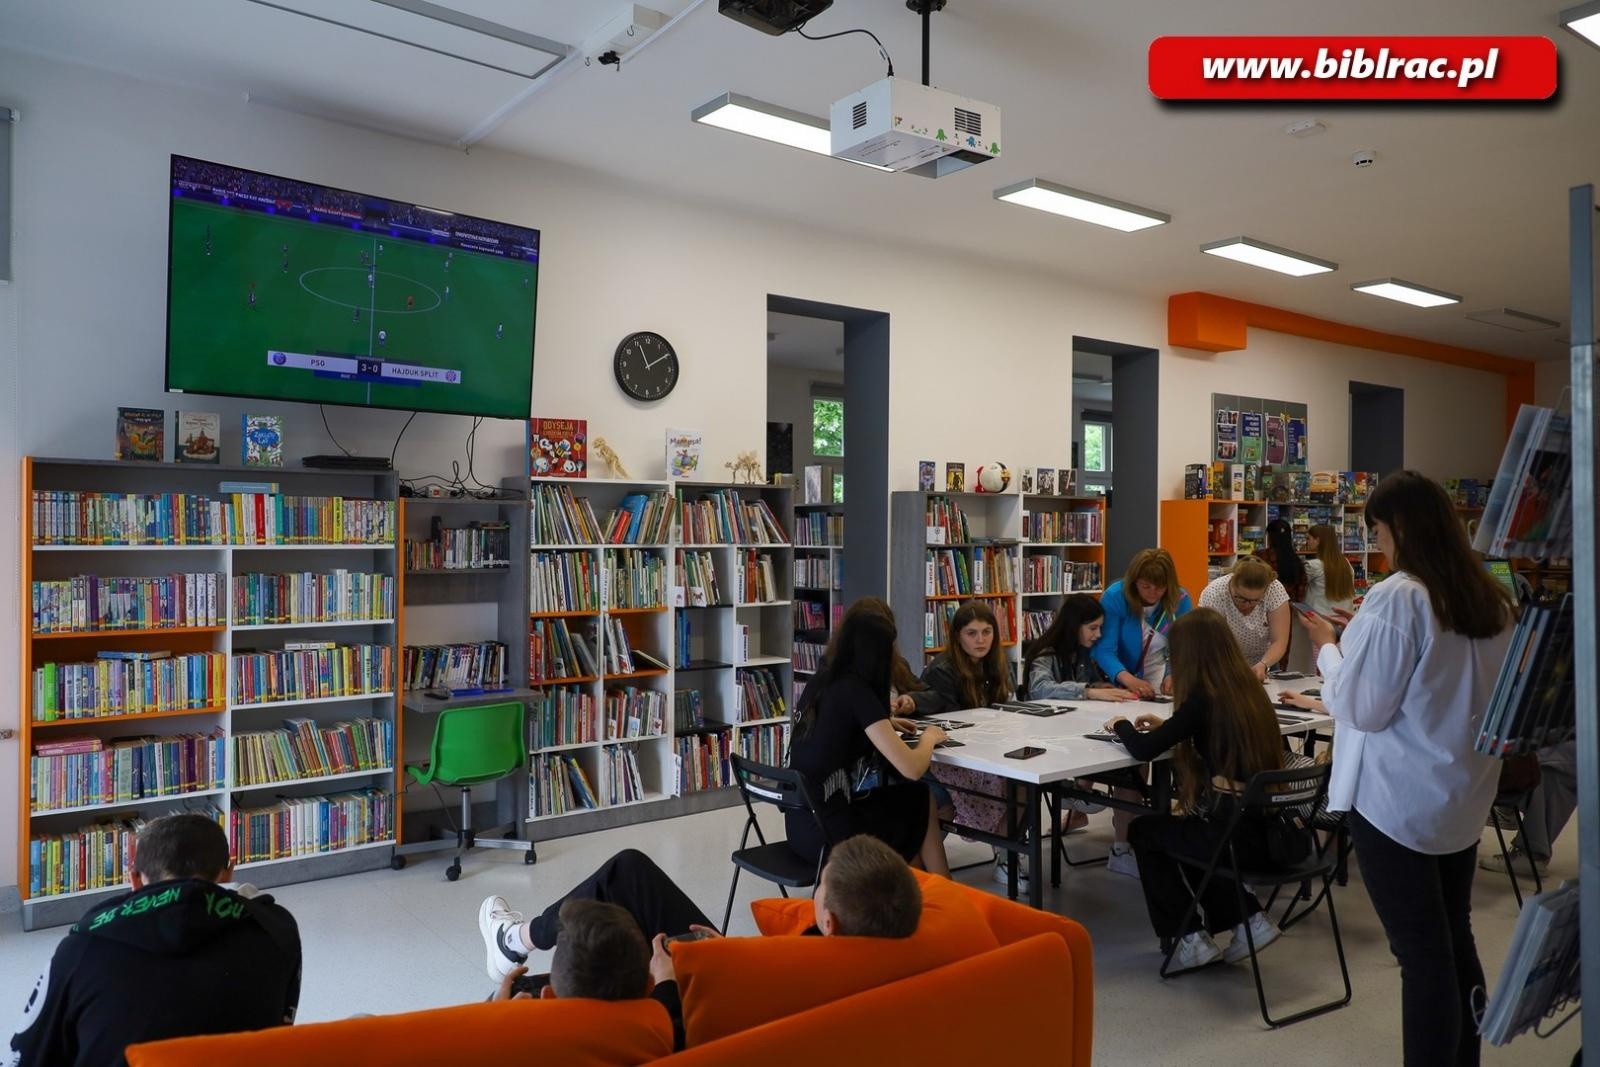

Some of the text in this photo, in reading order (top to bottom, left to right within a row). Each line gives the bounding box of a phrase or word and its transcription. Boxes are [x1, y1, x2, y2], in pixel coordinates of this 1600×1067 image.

[392, 367, 439, 378] HAJDUK SPLIT
[120, 887, 182, 918] NEVER
